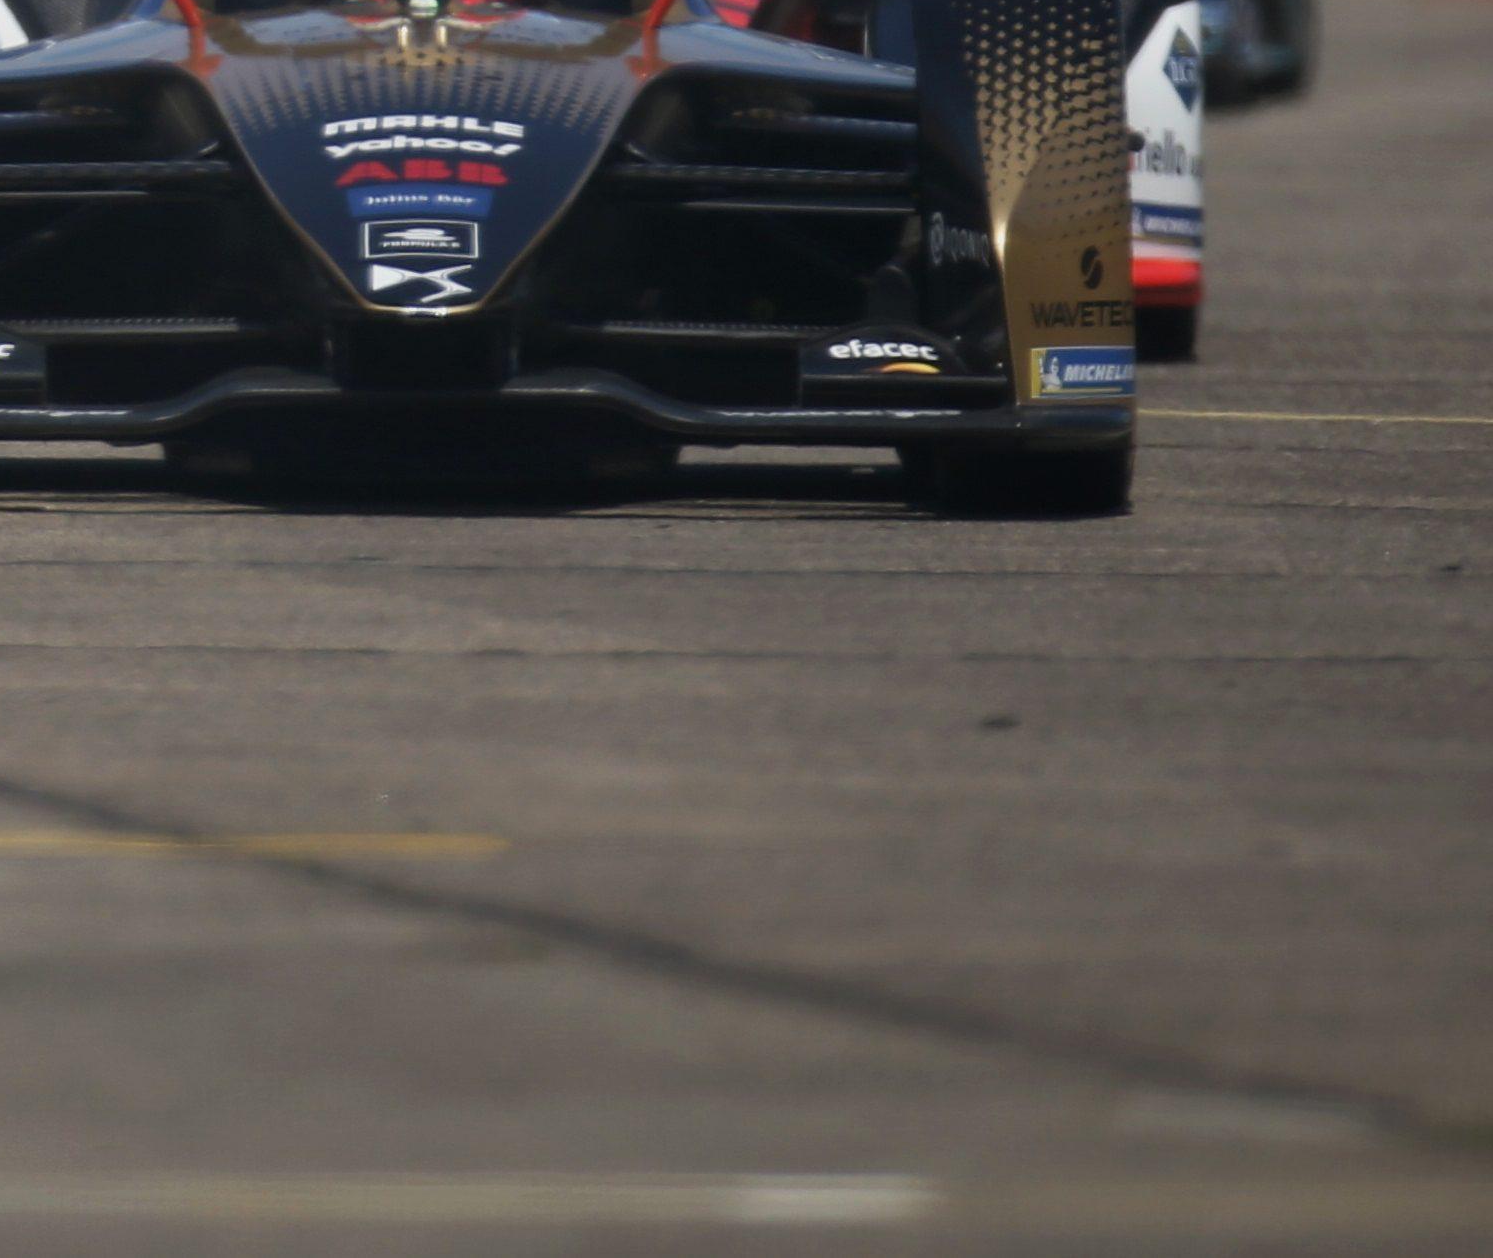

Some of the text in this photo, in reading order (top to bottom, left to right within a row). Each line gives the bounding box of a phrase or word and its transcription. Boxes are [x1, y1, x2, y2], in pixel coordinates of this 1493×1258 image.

[323, 115, 524, 138] MAHLE
[324, 135, 522, 158] yahoo!
[335, 158, 509, 188] ABB
[829, 338, 939, 361] efacec
